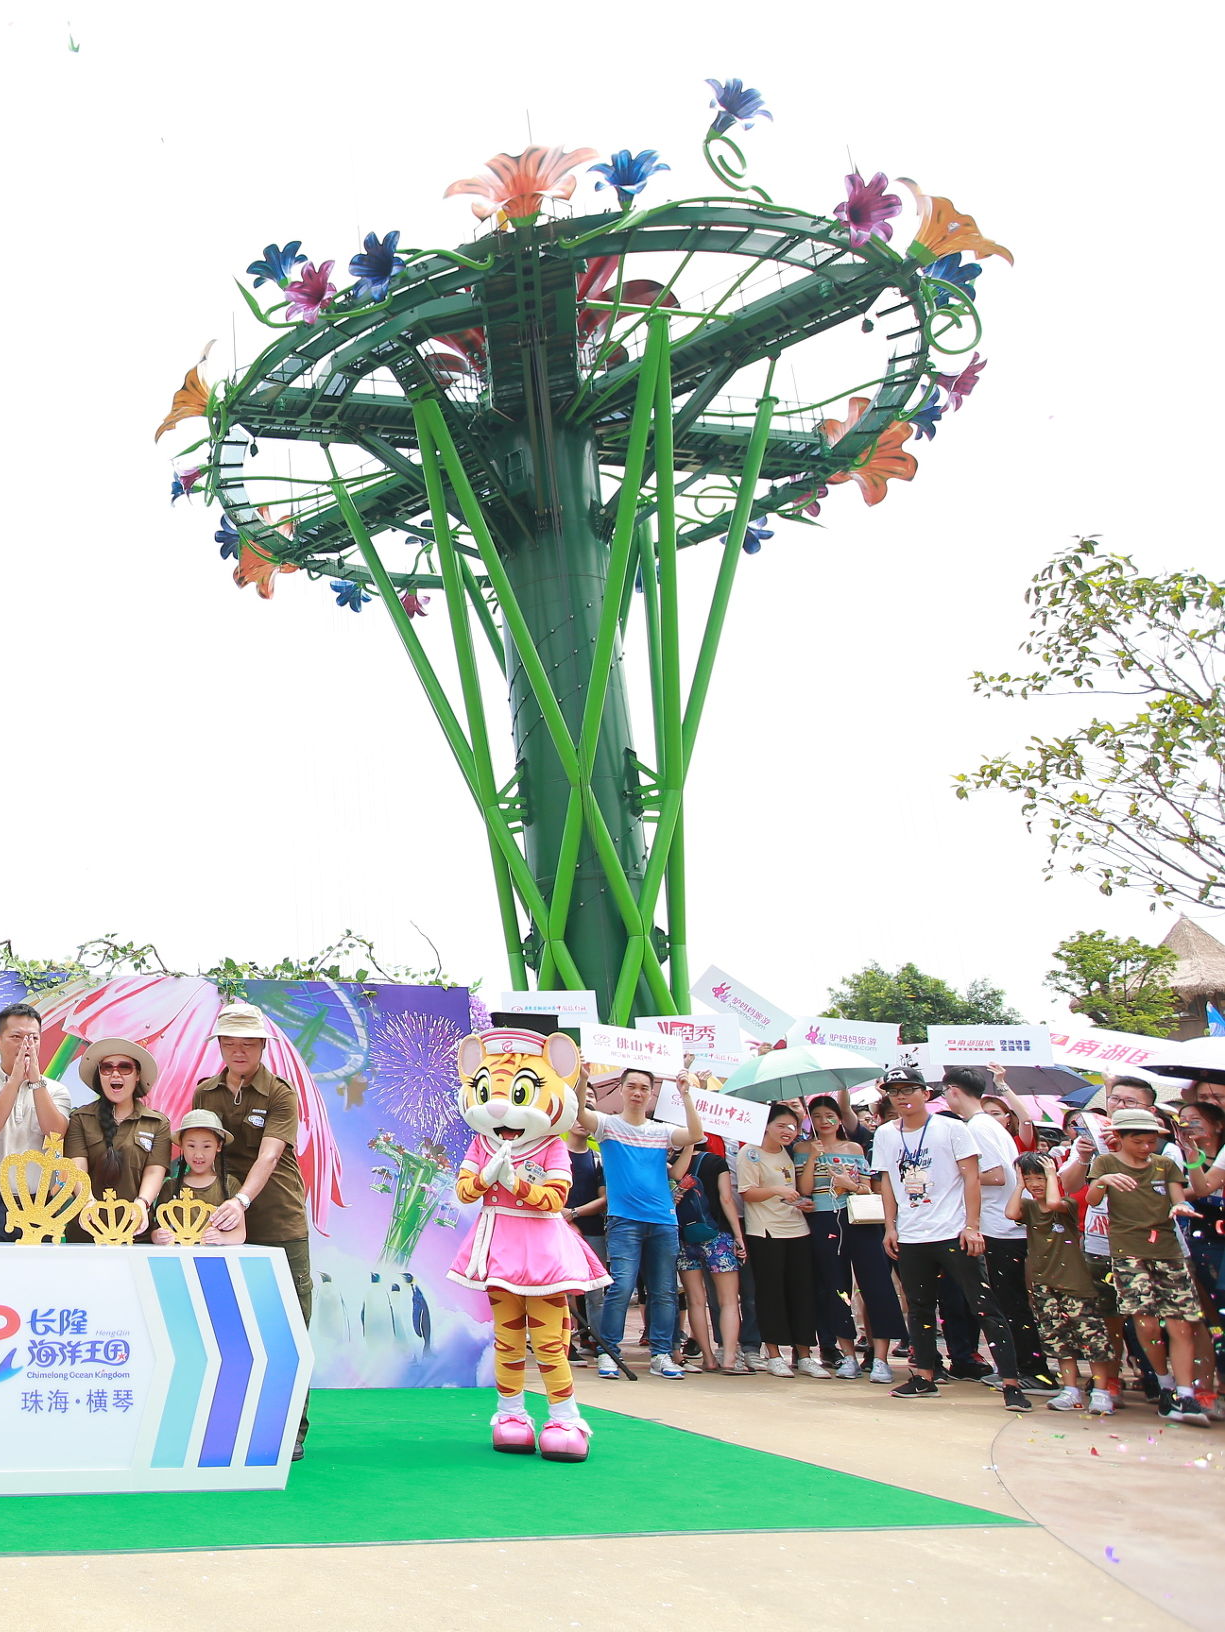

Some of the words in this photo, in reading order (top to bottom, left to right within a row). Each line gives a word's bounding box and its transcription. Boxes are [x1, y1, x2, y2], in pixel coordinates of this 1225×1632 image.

[26, 1308, 88, 1336] 长隆
[27, 1339, 131, 1368] 海洋王国
[26, 1371, 69, 1380] Chimelong
[69, 1371, 94, 1379] Ocean
[94, 1371, 130, 1380] Kingdom
[21, 1388, 134, 1414] 珠海·横琴
